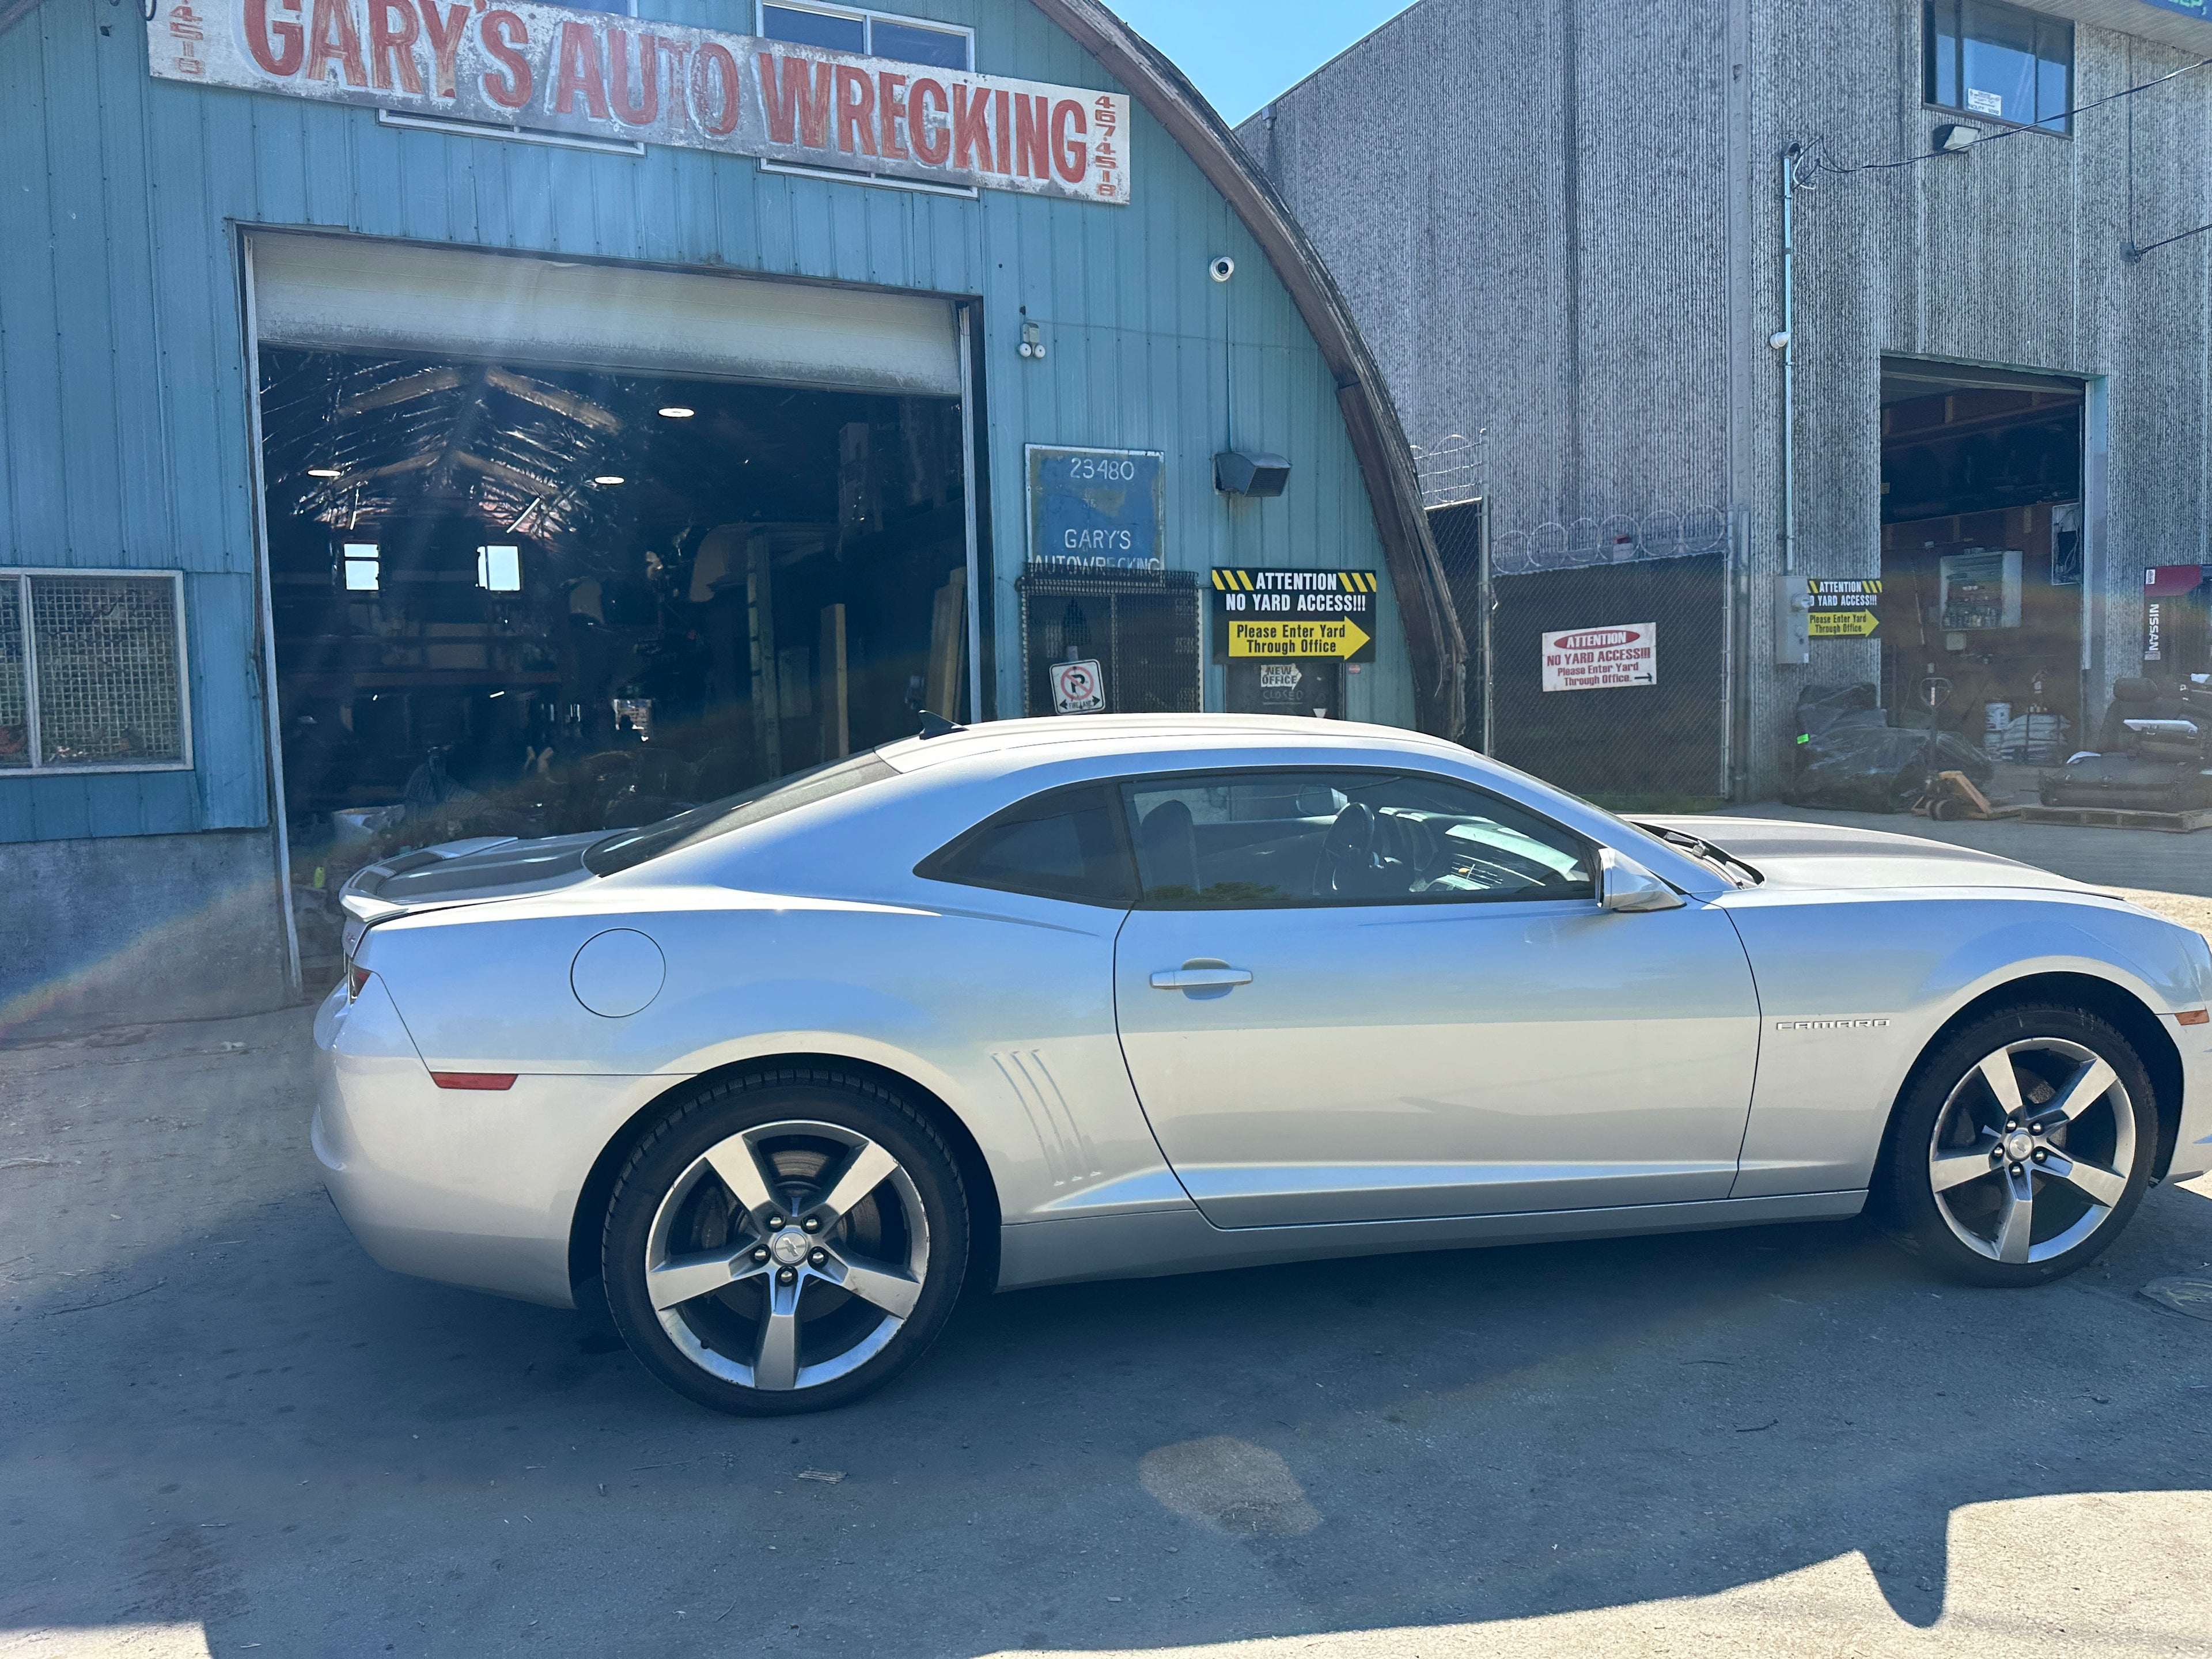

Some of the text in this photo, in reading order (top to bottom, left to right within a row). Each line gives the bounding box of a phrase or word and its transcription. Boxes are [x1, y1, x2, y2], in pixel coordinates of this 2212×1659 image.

[243, 0, 1088, 184] GARY'S AUTO WRECKING
[1070, 457, 1135, 480] 23480
[1065, 529, 1131, 550] GARY'S
[1256, 572, 1337, 590] ATTENTION
[1819, 581, 1862, 593] ATTENTION
[1226, 593, 1366, 612] NO YARD ACCESS!!!
[1818, 595, 1838, 607] YARD
[1841, 594, 1877, 606] ACCESS!!!
[1810, 613, 1866, 624] Please Enter Yard
[1237, 624, 1346, 638] Please Enter Yard
[1816, 624, 1862, 634] Through Office
[2149, 604, 2160, 651] NISSAN
[1566, 631, 1627, 648] ATTENTION
[1247, 639, 1336, 655] Through Office
[1547, 647, 1650, 666] NO YARD ACCESS!!!
[1266, 666, 1291, 675] NEW
[1558, 662, 1639, 676] Please Enter Yard
[1262, 675, 1297, 685] OFFICE
[1565, 675, 1600, 686] Through
[1777, 1019, 1891, 1031] CAMARO
